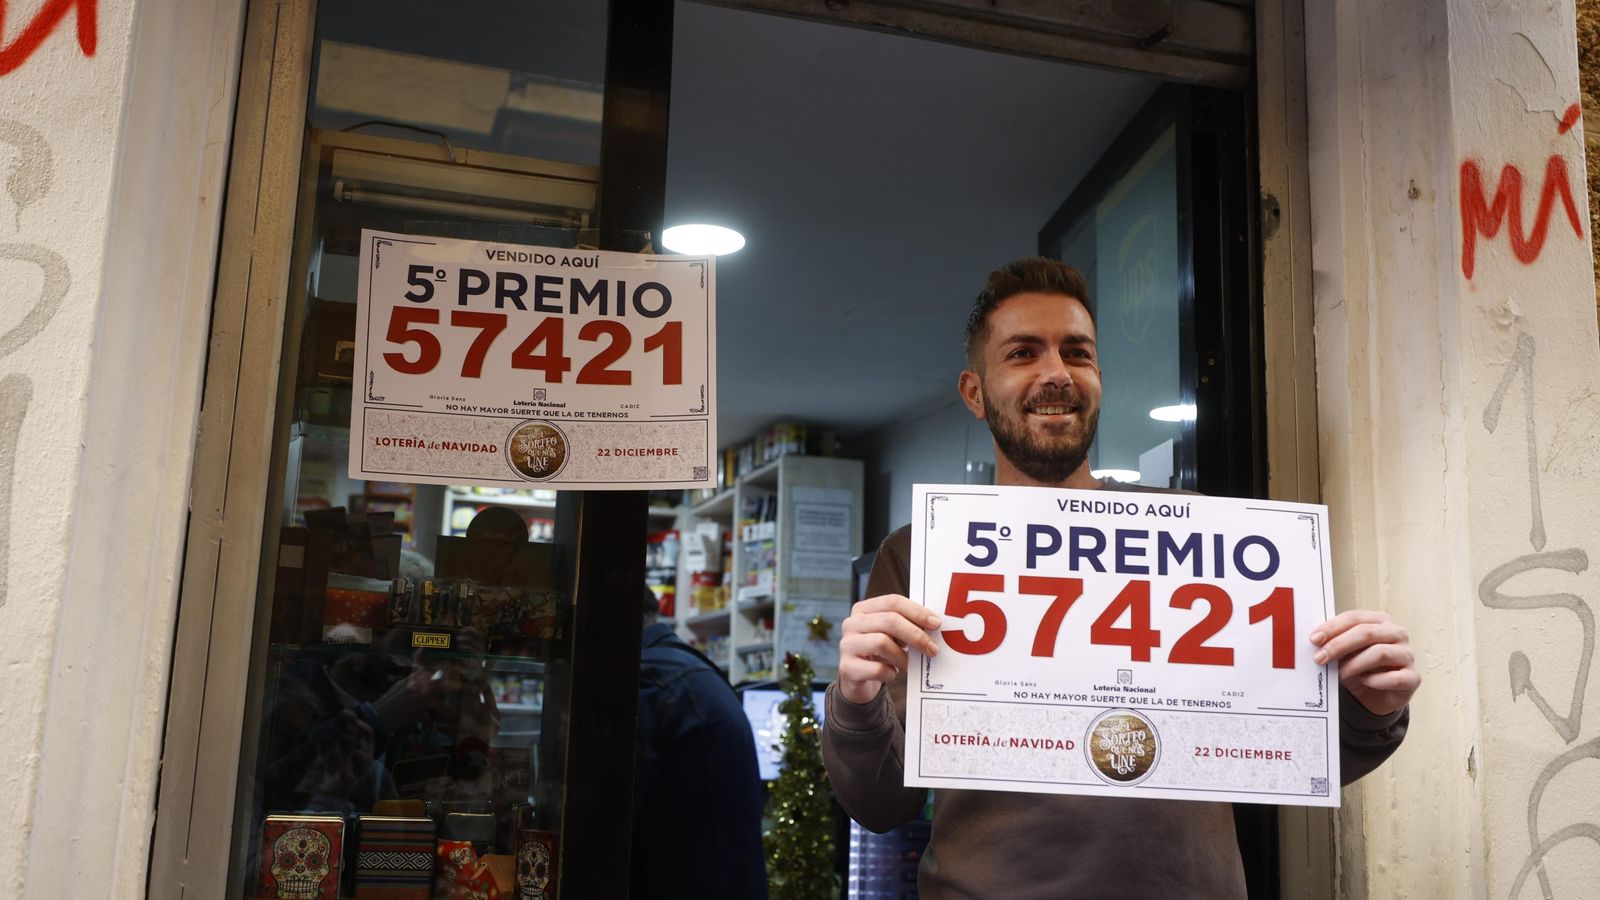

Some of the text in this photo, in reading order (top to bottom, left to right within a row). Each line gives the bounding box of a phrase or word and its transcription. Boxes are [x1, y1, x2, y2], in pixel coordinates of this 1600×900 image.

[486, 249, 599, 269] VENDIDO AQUÍ
[404, 265, 672, 318] 5º PREMIO
[382, 306, 682, 386] 57421
[446, 404, 458, 412] NO
[480, 406, 509, 414] MAYOR
[511, 408, 540, 416] SUERTE
[543, 410, 560, 418] QUE
[376, 436, 498, 454] LOTERÍA de NAVIDAD
[597, 447, 679, 457] 22 DICIEMBRE
[1057, 499, 1191, 520] VENDIDO AQUÍ
[964, 522, 1280, 582] 5º PREMIO
[940, 572, 1296, 670] 57421
[416, 635, 446, 645] CLIPPER
[1123, 685, 1156, 694] Nacional
[1221, 690, 1245, 698] CADIZ
[1013, 691, 1232, 709] NO HAY MAYOR SUERTE QUE LA DE TENERNOS
[934, 732, 1075, 751] LOTERÍA de NAVIDAD
[1100, 730, 1146, 750] SORTEO
[1107, 752, 1137, 774] UNE
[1194, 746, 1292, 761] 22 DICIEMBRE
